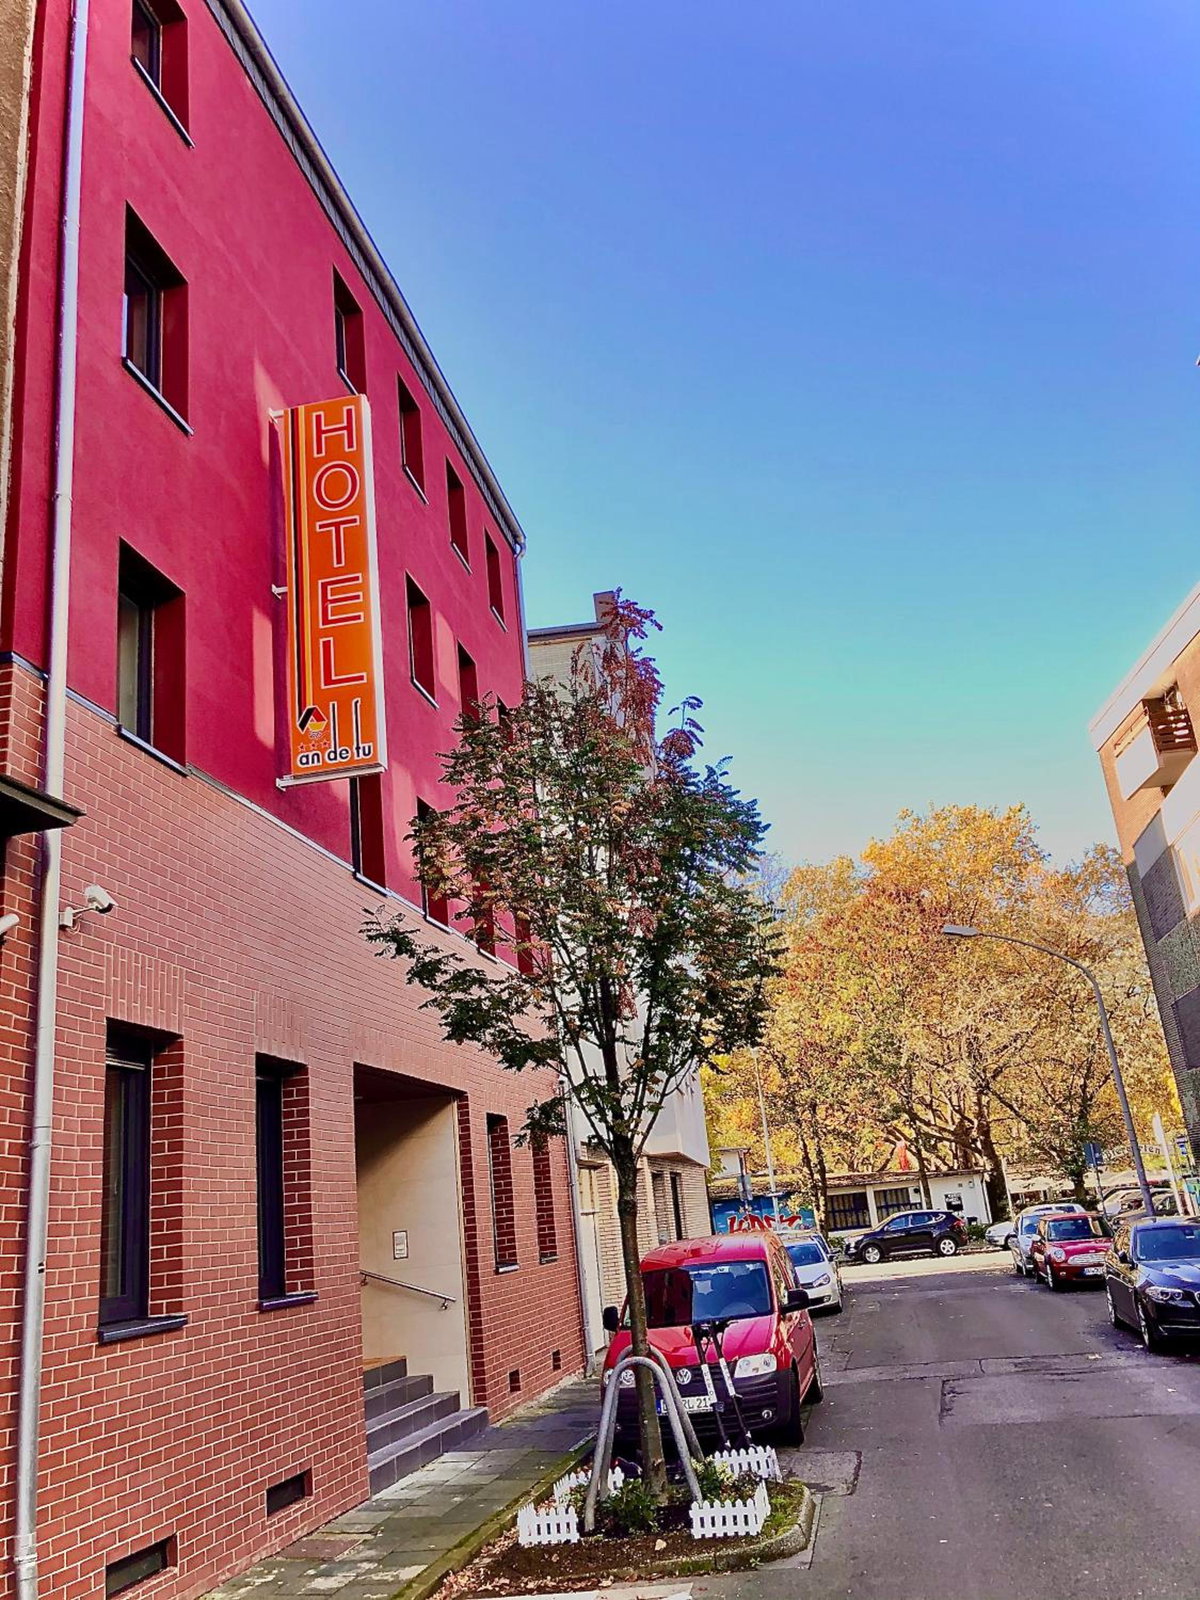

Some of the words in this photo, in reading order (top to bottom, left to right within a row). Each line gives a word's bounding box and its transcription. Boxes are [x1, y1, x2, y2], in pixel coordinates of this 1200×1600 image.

[313, 405, 367, 689] HOTEL
[298, 751, 321, 767] an
[326, 702, 350, 762] de
[352, 698, 372, 758] tu
